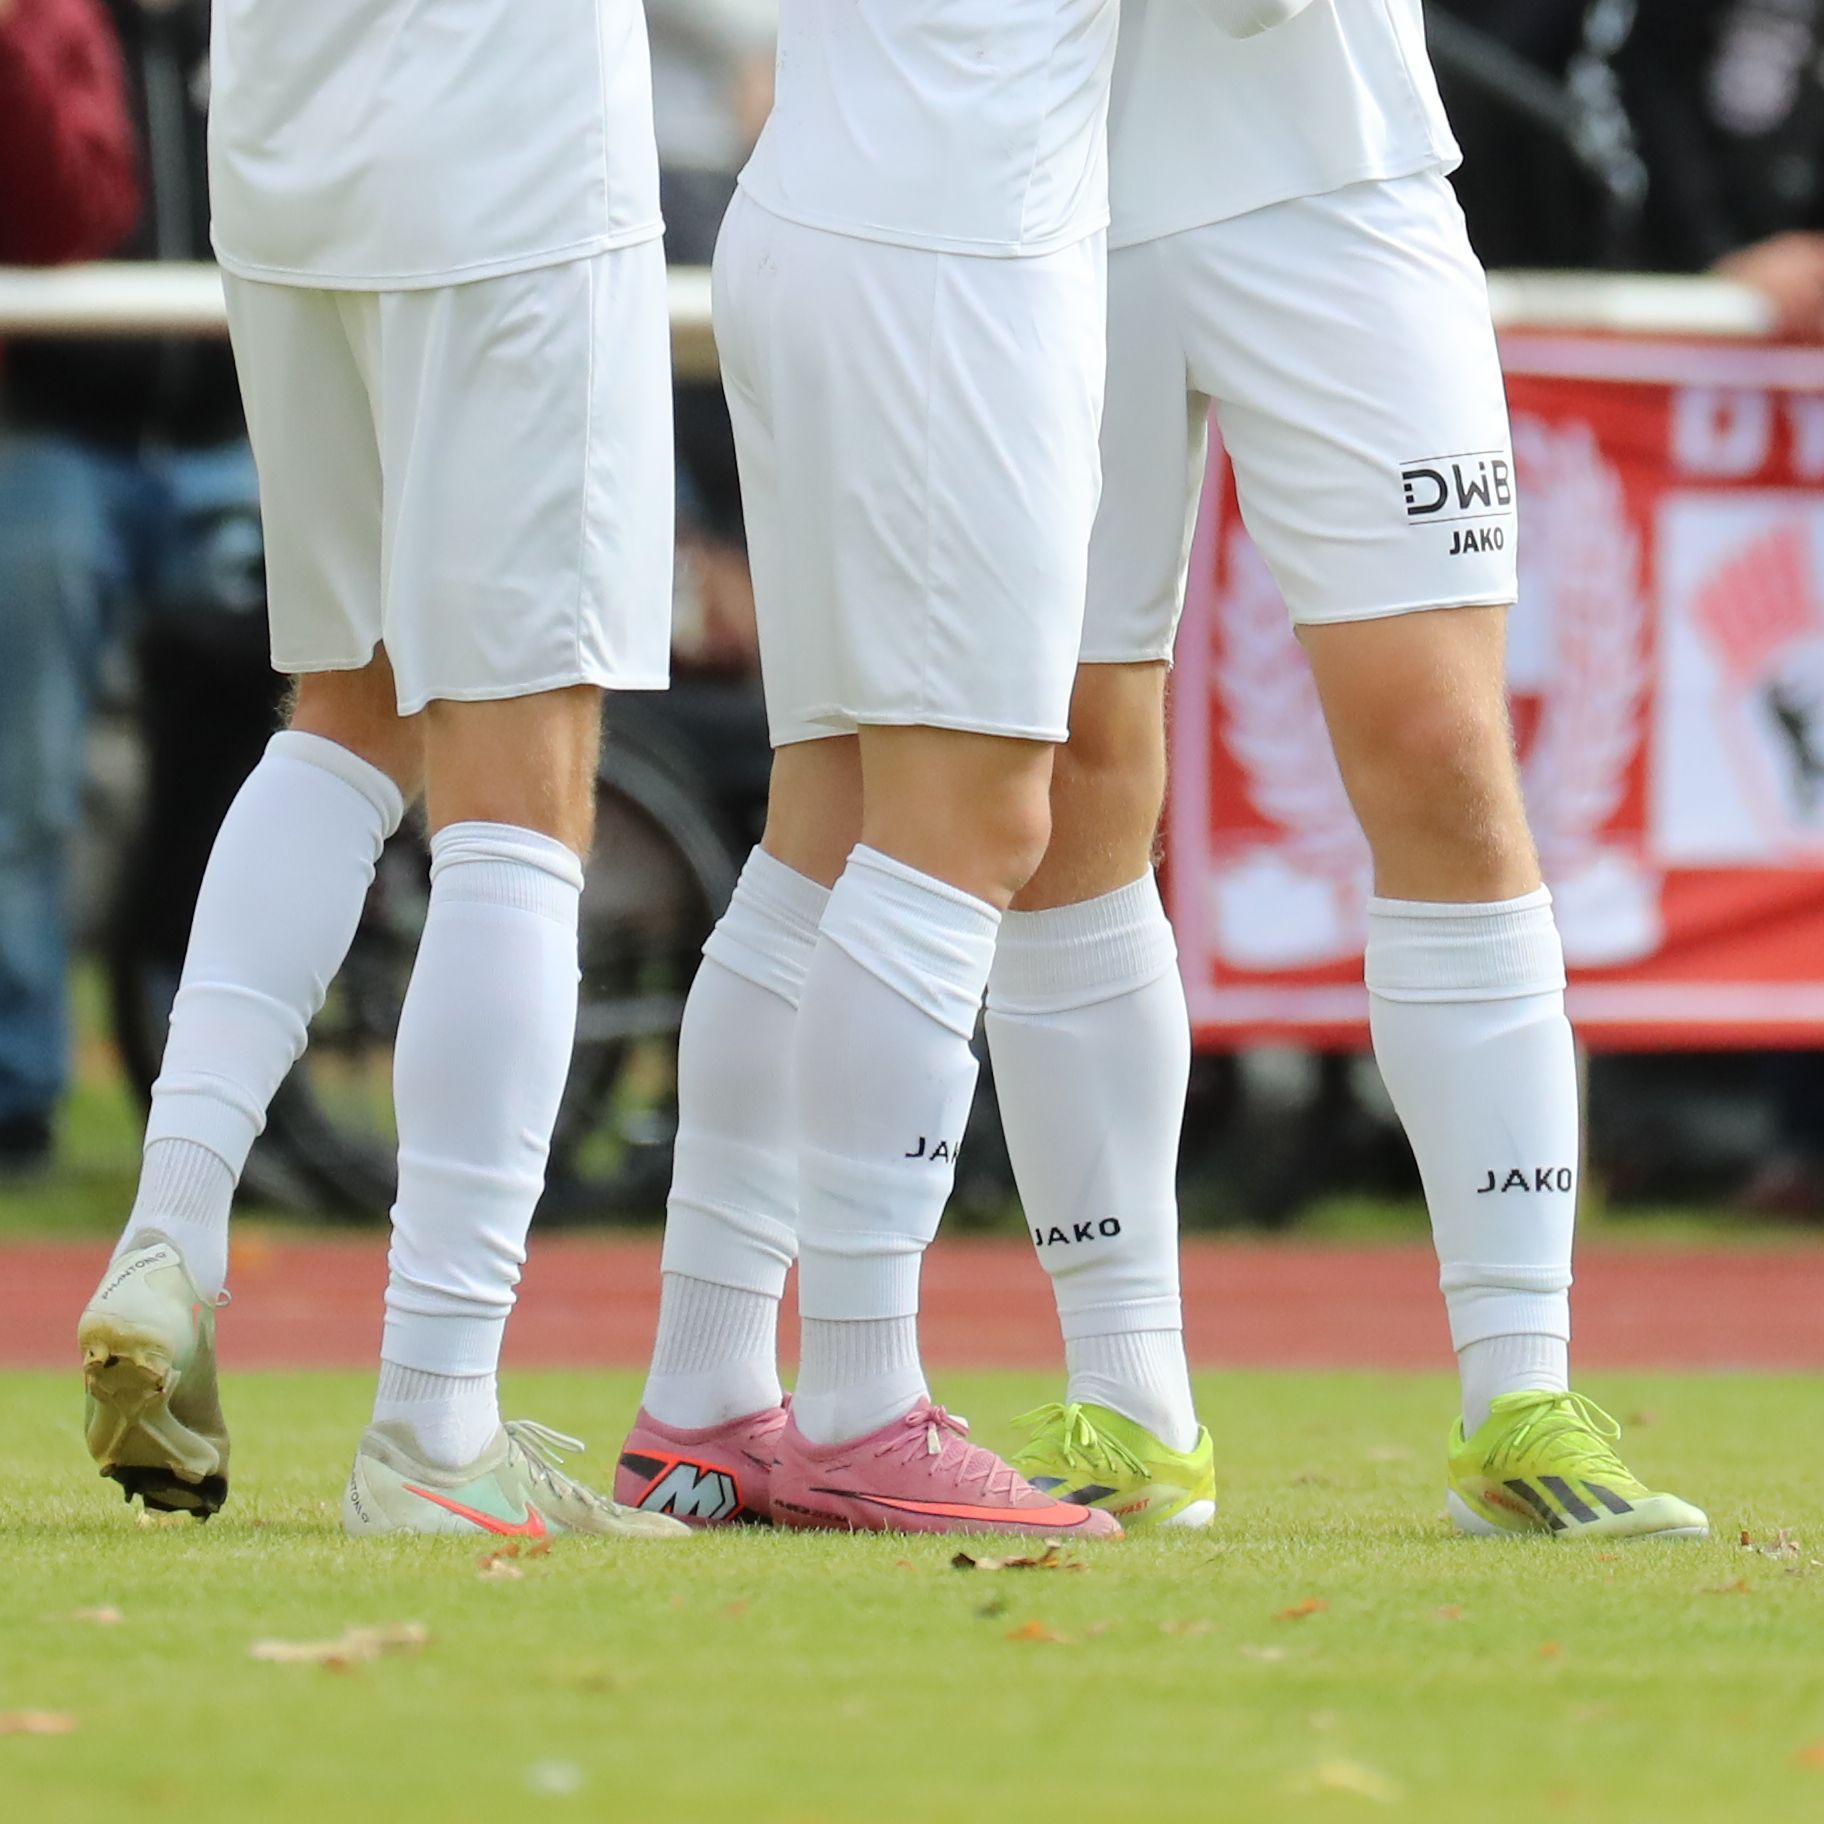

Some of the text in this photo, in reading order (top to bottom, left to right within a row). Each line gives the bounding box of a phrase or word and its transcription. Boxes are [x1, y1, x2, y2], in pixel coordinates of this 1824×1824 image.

[1449, 527, 1504, 556] JAKO
[1477, 1167, 1572, 1193] JAKO
[1034, 1217, 1121, 1247] JAKO
